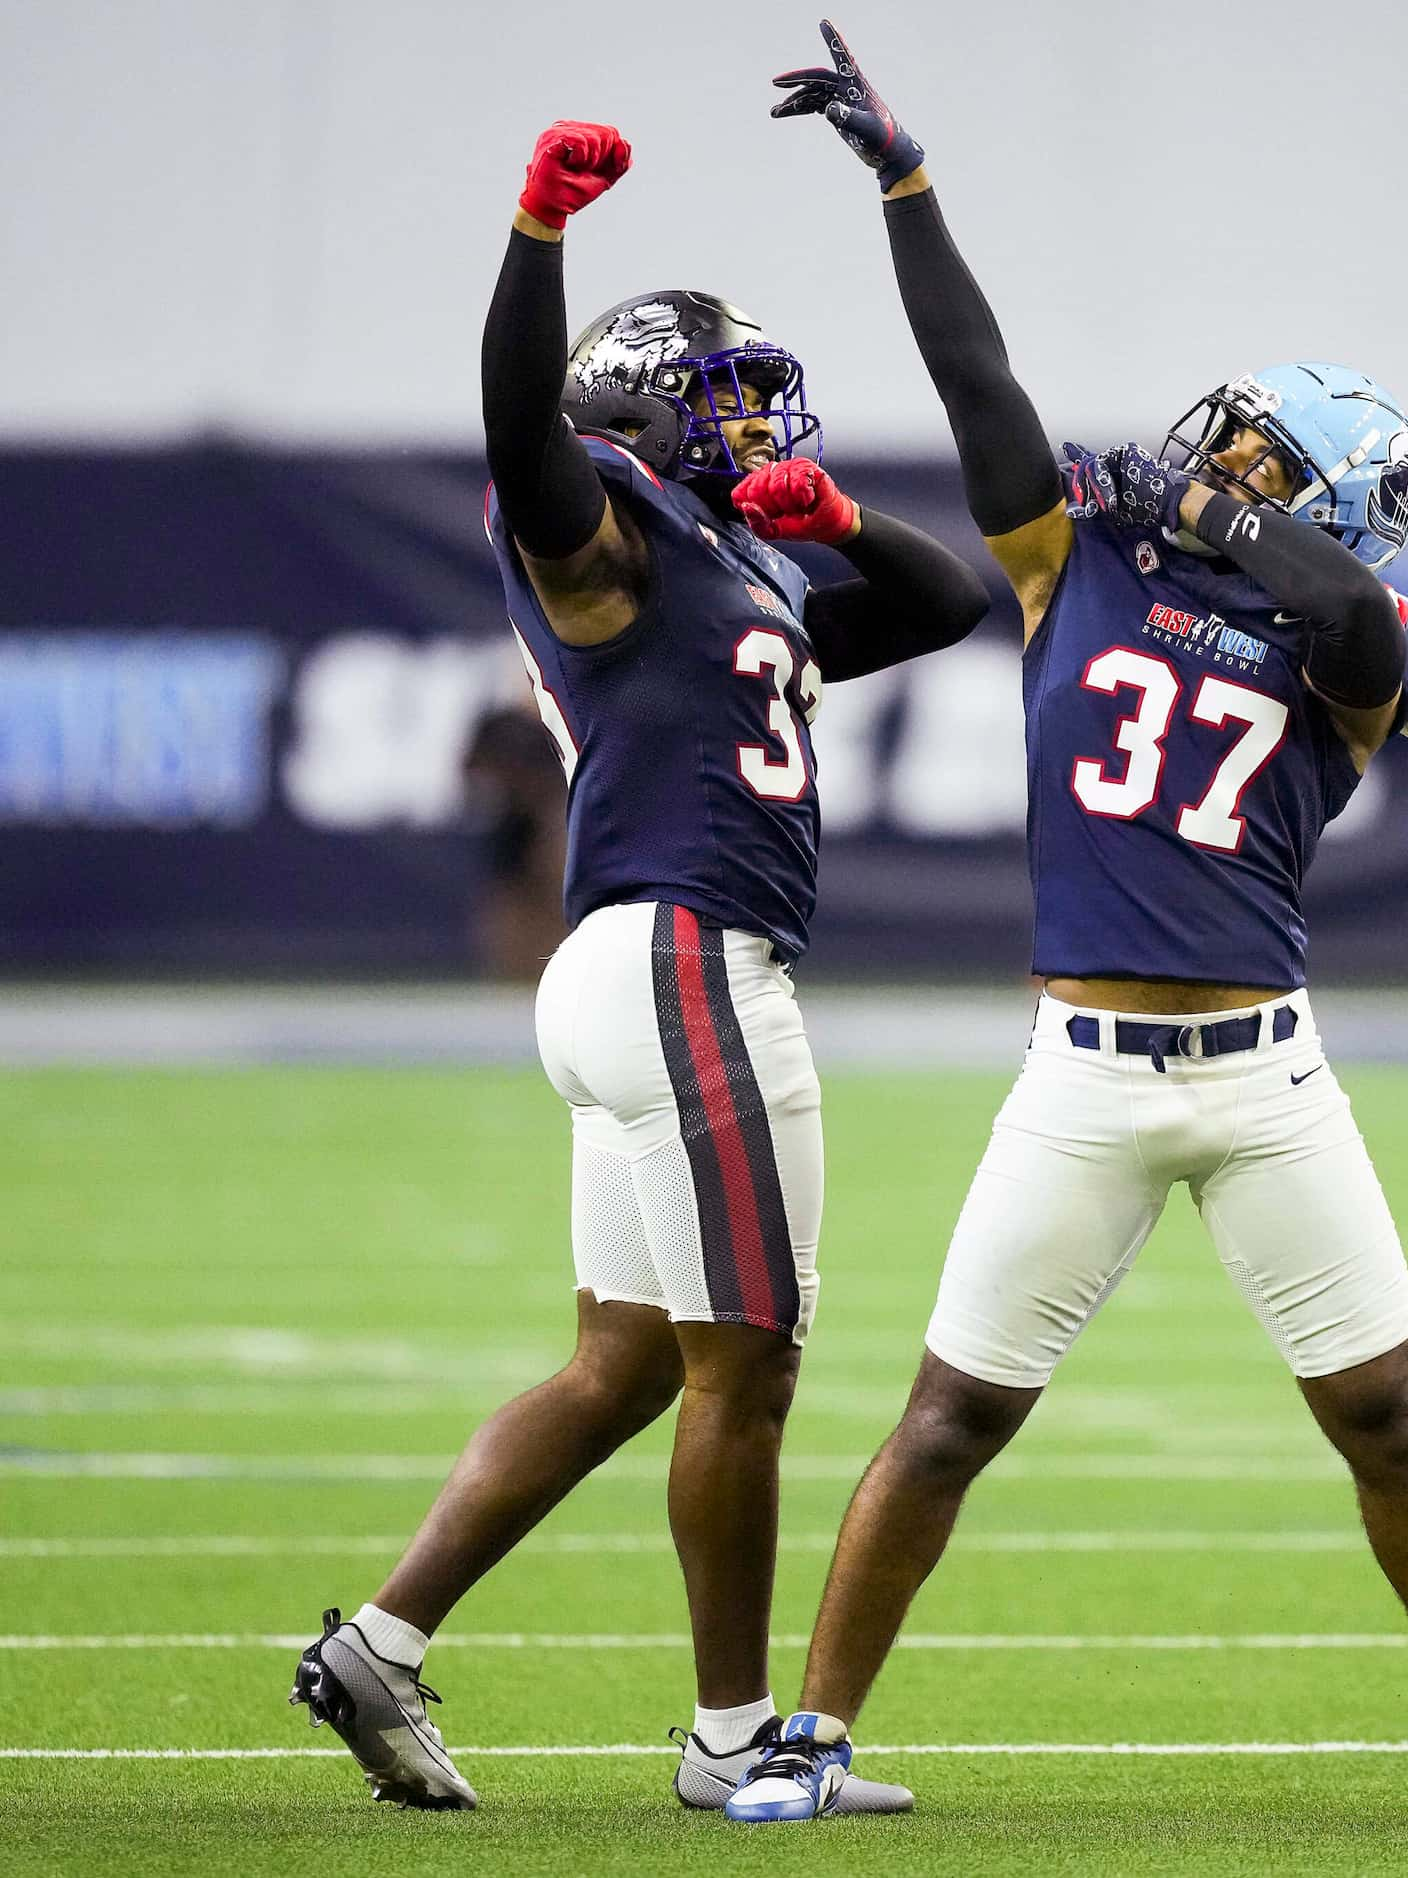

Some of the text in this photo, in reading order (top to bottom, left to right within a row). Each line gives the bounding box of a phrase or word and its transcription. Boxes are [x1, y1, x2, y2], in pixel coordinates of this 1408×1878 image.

[1142, 625, 1261, 676] SHRINE BOWL
[1147, 602, 1269, 663] EAST WEST
[1071, 645, 1289, 854] 37
